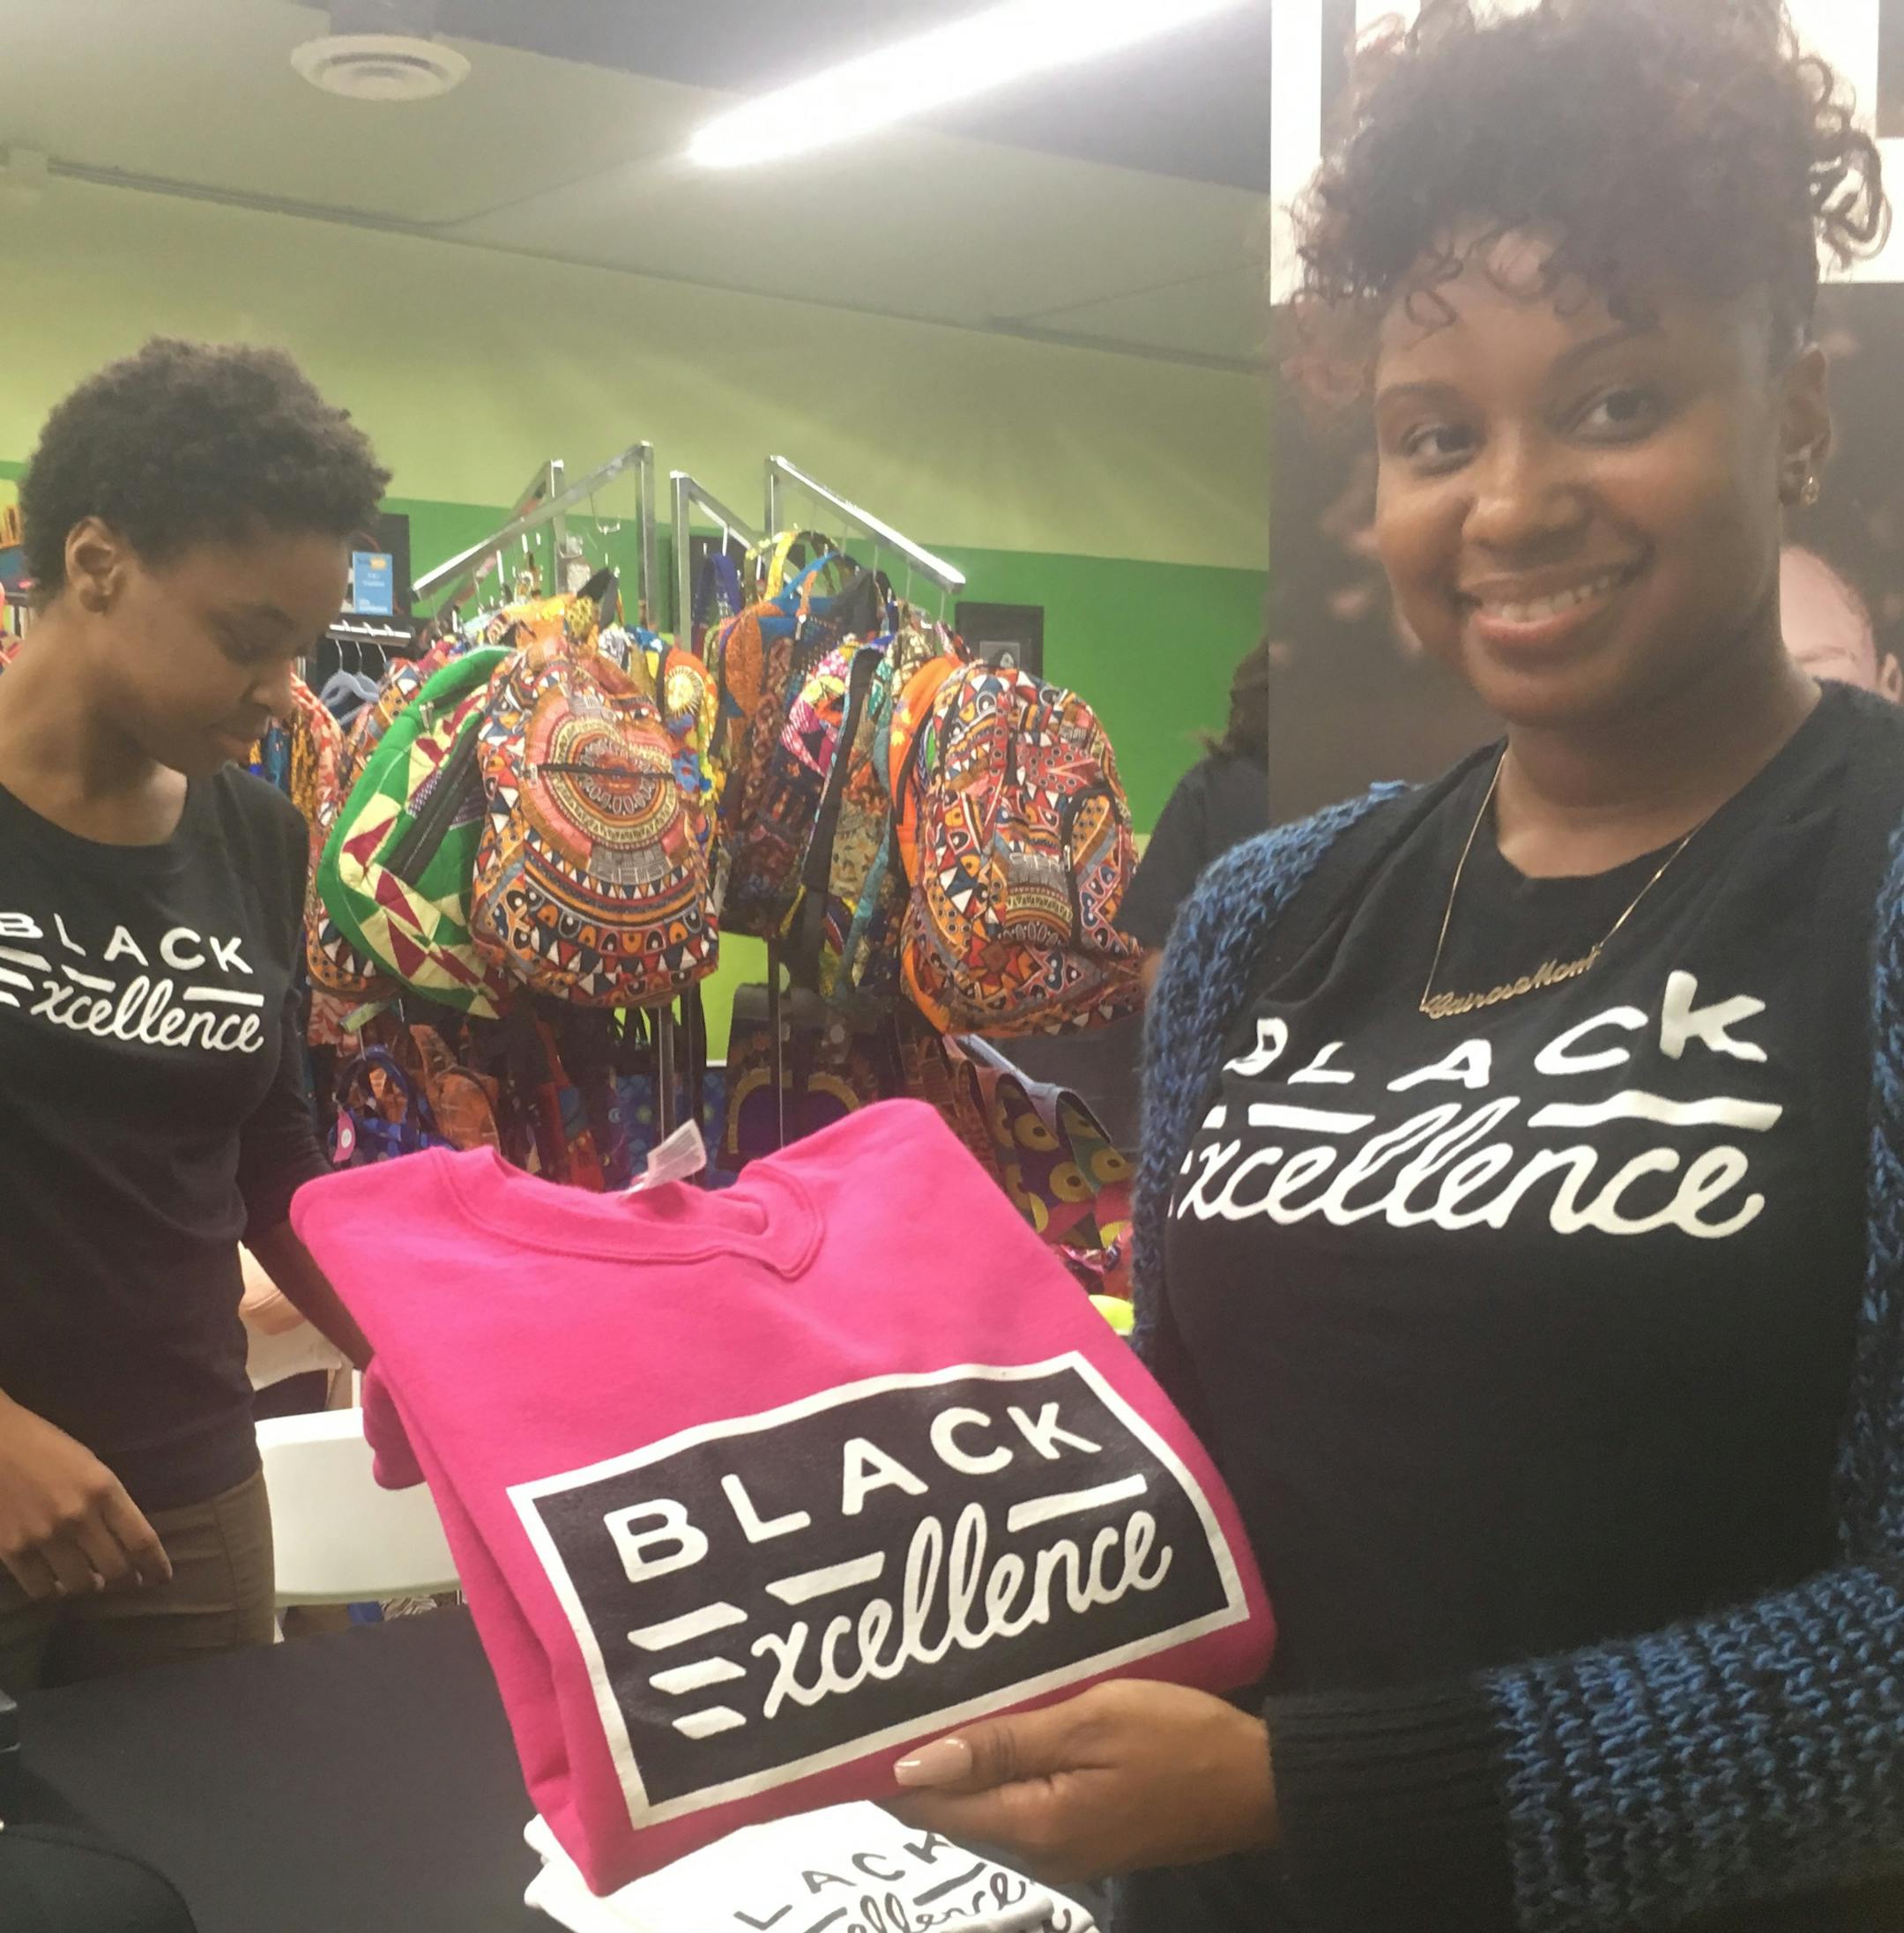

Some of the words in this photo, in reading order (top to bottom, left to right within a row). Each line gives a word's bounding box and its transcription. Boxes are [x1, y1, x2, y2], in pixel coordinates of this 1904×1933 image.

[0, 912, 254, 974] BLACK
[1168, 1096, 1766, 1238] xcellence
[604, 1401, 1101, 1582] BLACK
[628, 1502, 1172, 1739] Excellence
[733, 1833, 955, 1931] LACK
